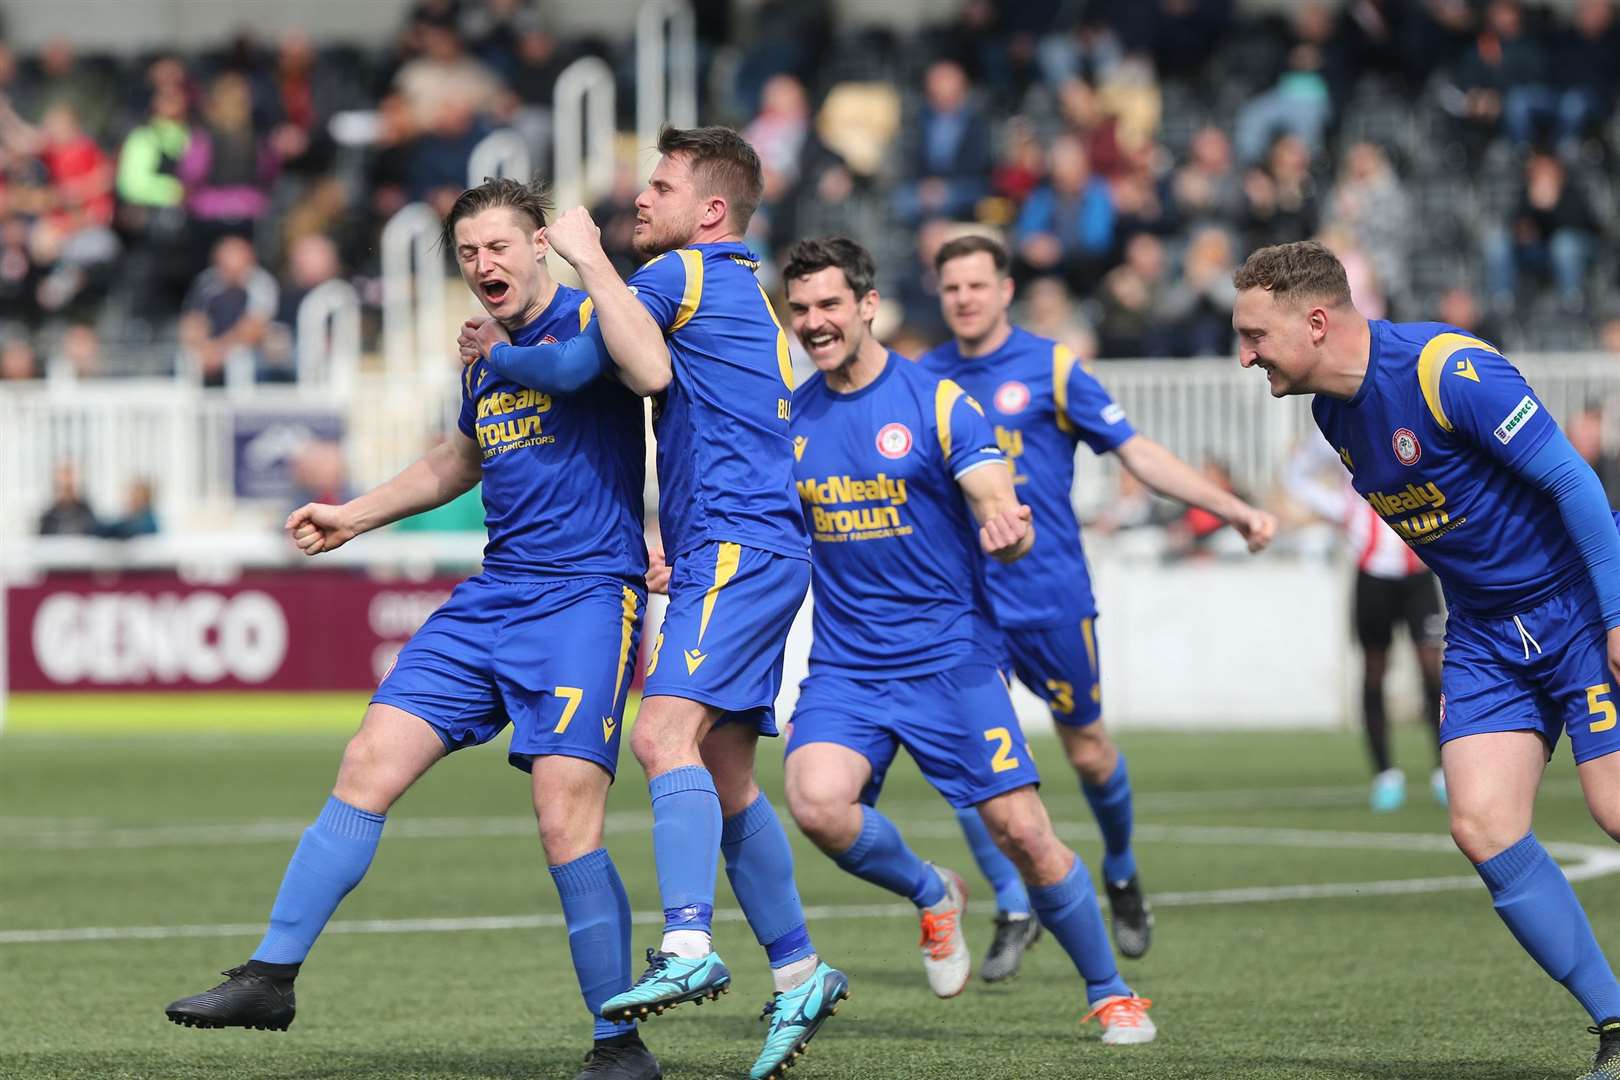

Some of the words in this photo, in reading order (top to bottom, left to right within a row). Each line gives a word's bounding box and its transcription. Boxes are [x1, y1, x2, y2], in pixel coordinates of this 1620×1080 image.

[475, 415, 543, 449] rown
[1505, 400, 1534, 432] RESPECT
[796, 473, 907, 505] McNealy
[812, 505, 900, 533] Brown
[31, 590, 290, 685] GENCO
[553, 686, 584, 734] 7
[1046, 677, 1075, 716] 3
[1585, 682, 1618, 734] 5
[983, 726, 1019, 773] 2
